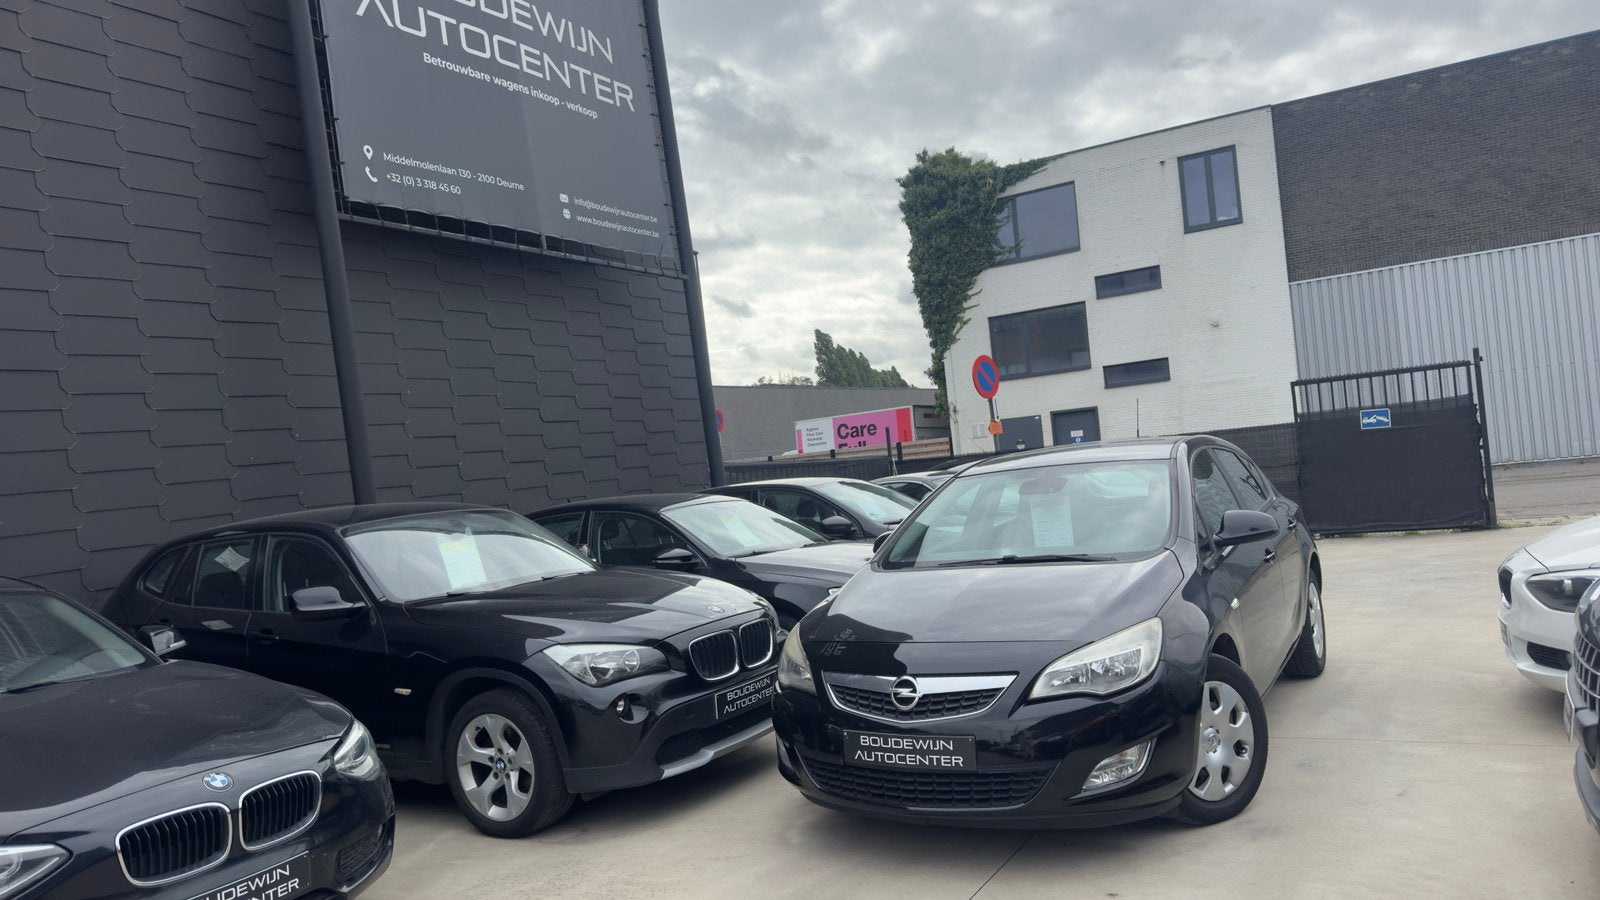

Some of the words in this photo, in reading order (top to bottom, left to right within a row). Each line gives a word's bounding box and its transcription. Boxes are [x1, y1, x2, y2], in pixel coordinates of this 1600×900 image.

[356, 0, 635, 112] AUTOCENTER
[423, 52, 491, 82] Betrouwbare
[492, 75, 530, 95] wagens
[530, 86, 560, 107] inkoop
[565, 101, 598, 120] verkoop
[383, 152, 457, 175] Middelmolenlaan
[458, 168, 472, 179] 130
[477, 173, 496, 185] 2100
[496, 177, 525, 191] Deurne
[386, 172, 402, 184] +32
[402, 175, 415, 187] (0)
[416, 177, 422, 187] 3
[422, 179, 437, 190] 318
[438, 183, 449, 192] 45
[450, 185, 462, 195] 60
[576, 215, 659, 238] www.boudewijnautocenter.be
[837, 423, 878, 440] Care
[727, 676, 771, 701] BOUDEWIJN
[859, 735, 954, 751] BOUDEWIJN
[854, 750, 964, 767] AUTOCENTER
